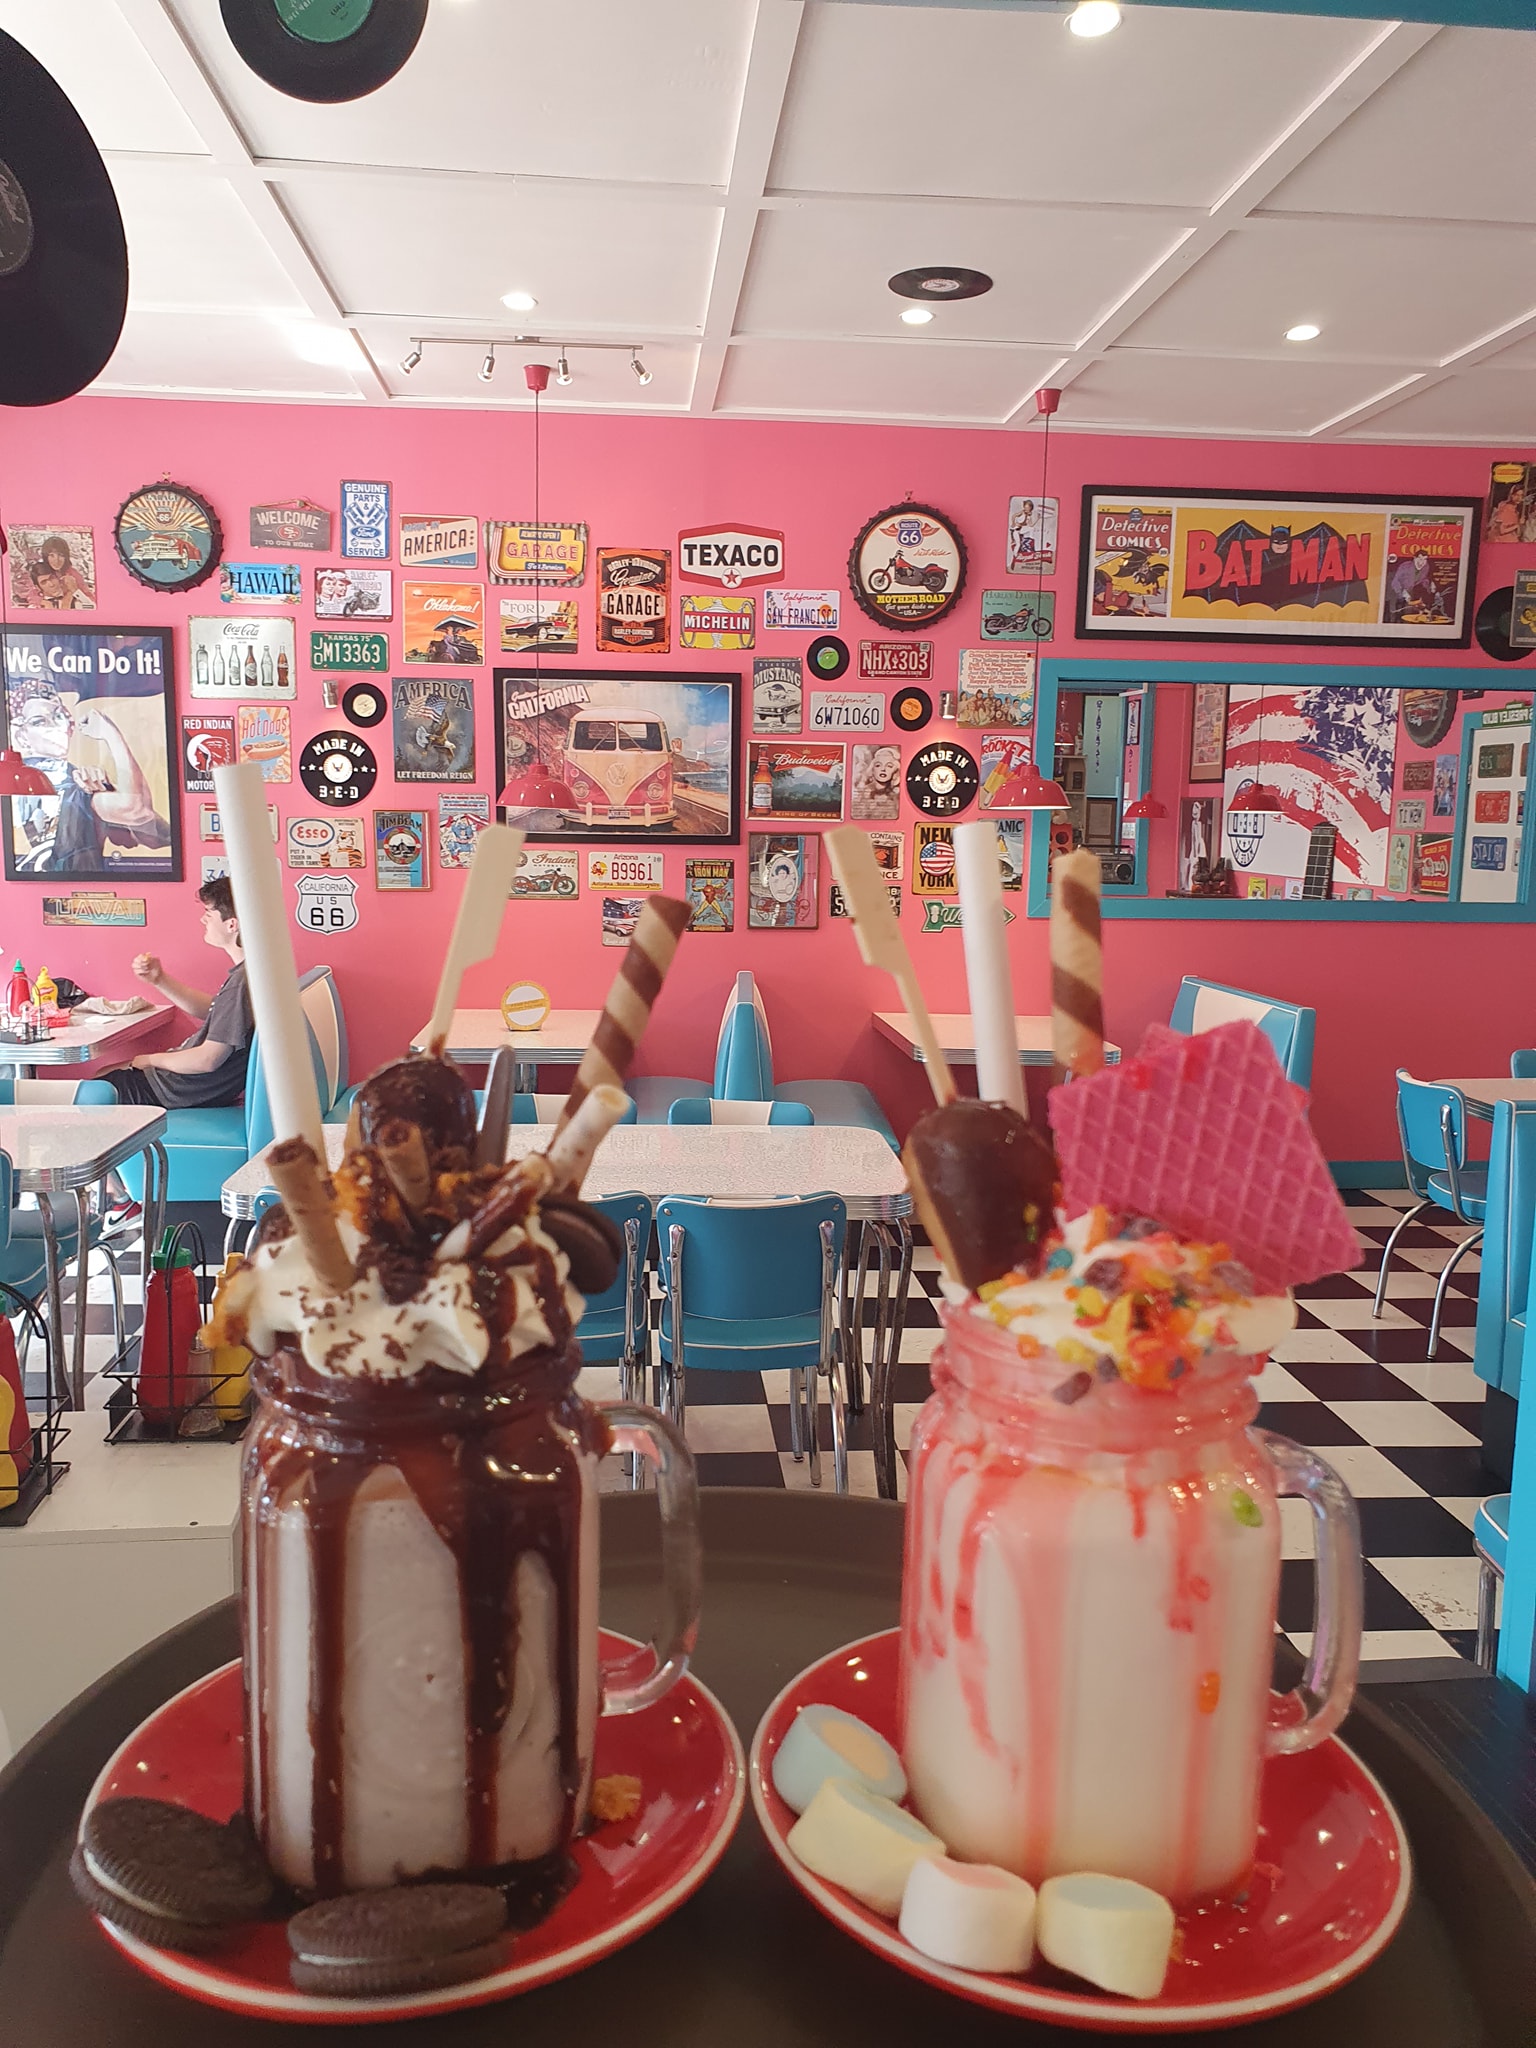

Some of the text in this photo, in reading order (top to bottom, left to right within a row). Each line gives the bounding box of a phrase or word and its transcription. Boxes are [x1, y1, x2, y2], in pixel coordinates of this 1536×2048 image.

[344, 483, 387, 493] GENUINE
[353, 493, 381, 502] PARTS
[256, 510, 321, 530] WELCOME
[1101, 516, 1169, 533] Detective
[900, 530, 919, 543] 66
[1396, 525, 1461, 540] Detective
[404, 528, 467, 557] AMERICA
[1107, 535, 1162, 549] COMICS
[1401, 543, 1454, 556] COMICS
[347, 547, 384, 556] SERVICE
[507, 542, 578, 561] GARAGE
[683, 543, 779, 567] TEXACO
[1185, 530, 1270, 591] BAT
[1289, 533, 1371, 586] MAN
[229, 571, 294, 594] HAWAII
[610, 568, 656, 594] Genuine
[423, 598, 481, 613] Oklahoma!
[607, 593, 660, 615] GARAGE
[876, 594, 945, 603] MOTHER ROAD
[510, 603, 545, 614] FORD
[766, 608, 837, 625] SAN FRANCISCO
[684, 614, 750, 630] MICHELIN
[328, 634, 359, 642] KANSAS
[7, 647, 161, 675] We Can Do It!
[323, 643, 381, 664] M13363
[754, 666, 801, 687] MUSTANG
[394, 680, 473, 712] AMERICA
[507, 683, 591, 720] CALIFORNIA
[825, 693, 871, 707] California
[183, 719, 232, 730] RED INDIAN
[815, 707, 880, 726] 6W71060
[312, 738, 366, 757] MADE IN
[982, 739, 1031, 758] ROCKET
[773, 753, 841, 767] Budweiser
[919, 750, 970, 769] MADE IN
[396, 770, 473, 780] LET FREEDOM REIGN
[871, 832, 903, 843] CONTAINS
[920, 827, 954, 844] NEW
[532, 853, 577, 865] Indian
[613, 853, 639, 861] Arizona
[612, 862, 653, 881] B9961
[693, 865, 730, 878] IRON MAN
[303, 883, 351, 892] CALIFORNIA
[919, 872, 955, 888] YORK
[310, 908, 344, 927] 66
